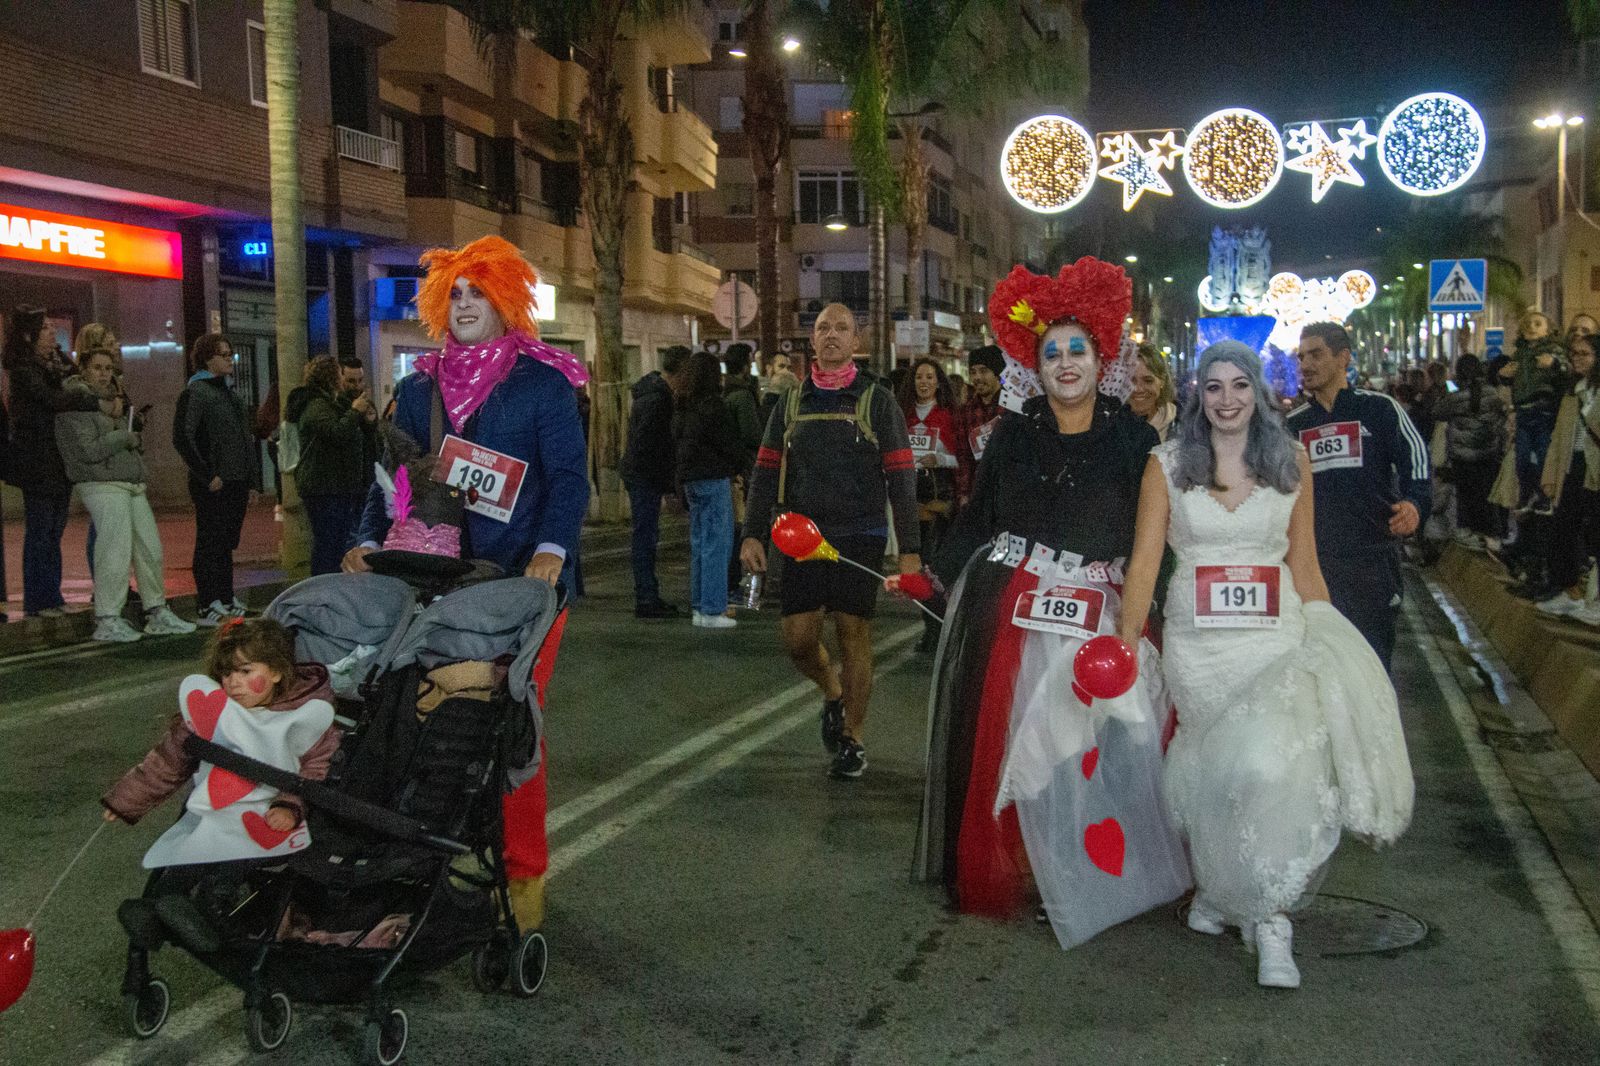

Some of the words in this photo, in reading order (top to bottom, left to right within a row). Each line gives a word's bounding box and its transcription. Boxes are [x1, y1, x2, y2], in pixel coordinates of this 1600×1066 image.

[910, 436, 927, 447] 530
[1315, 438, 1343, 456] 663
[459, 464, 496, 494] 190
[1220, 585, 1257, 607] 191
[1041, 599, 1079, 619] 189
